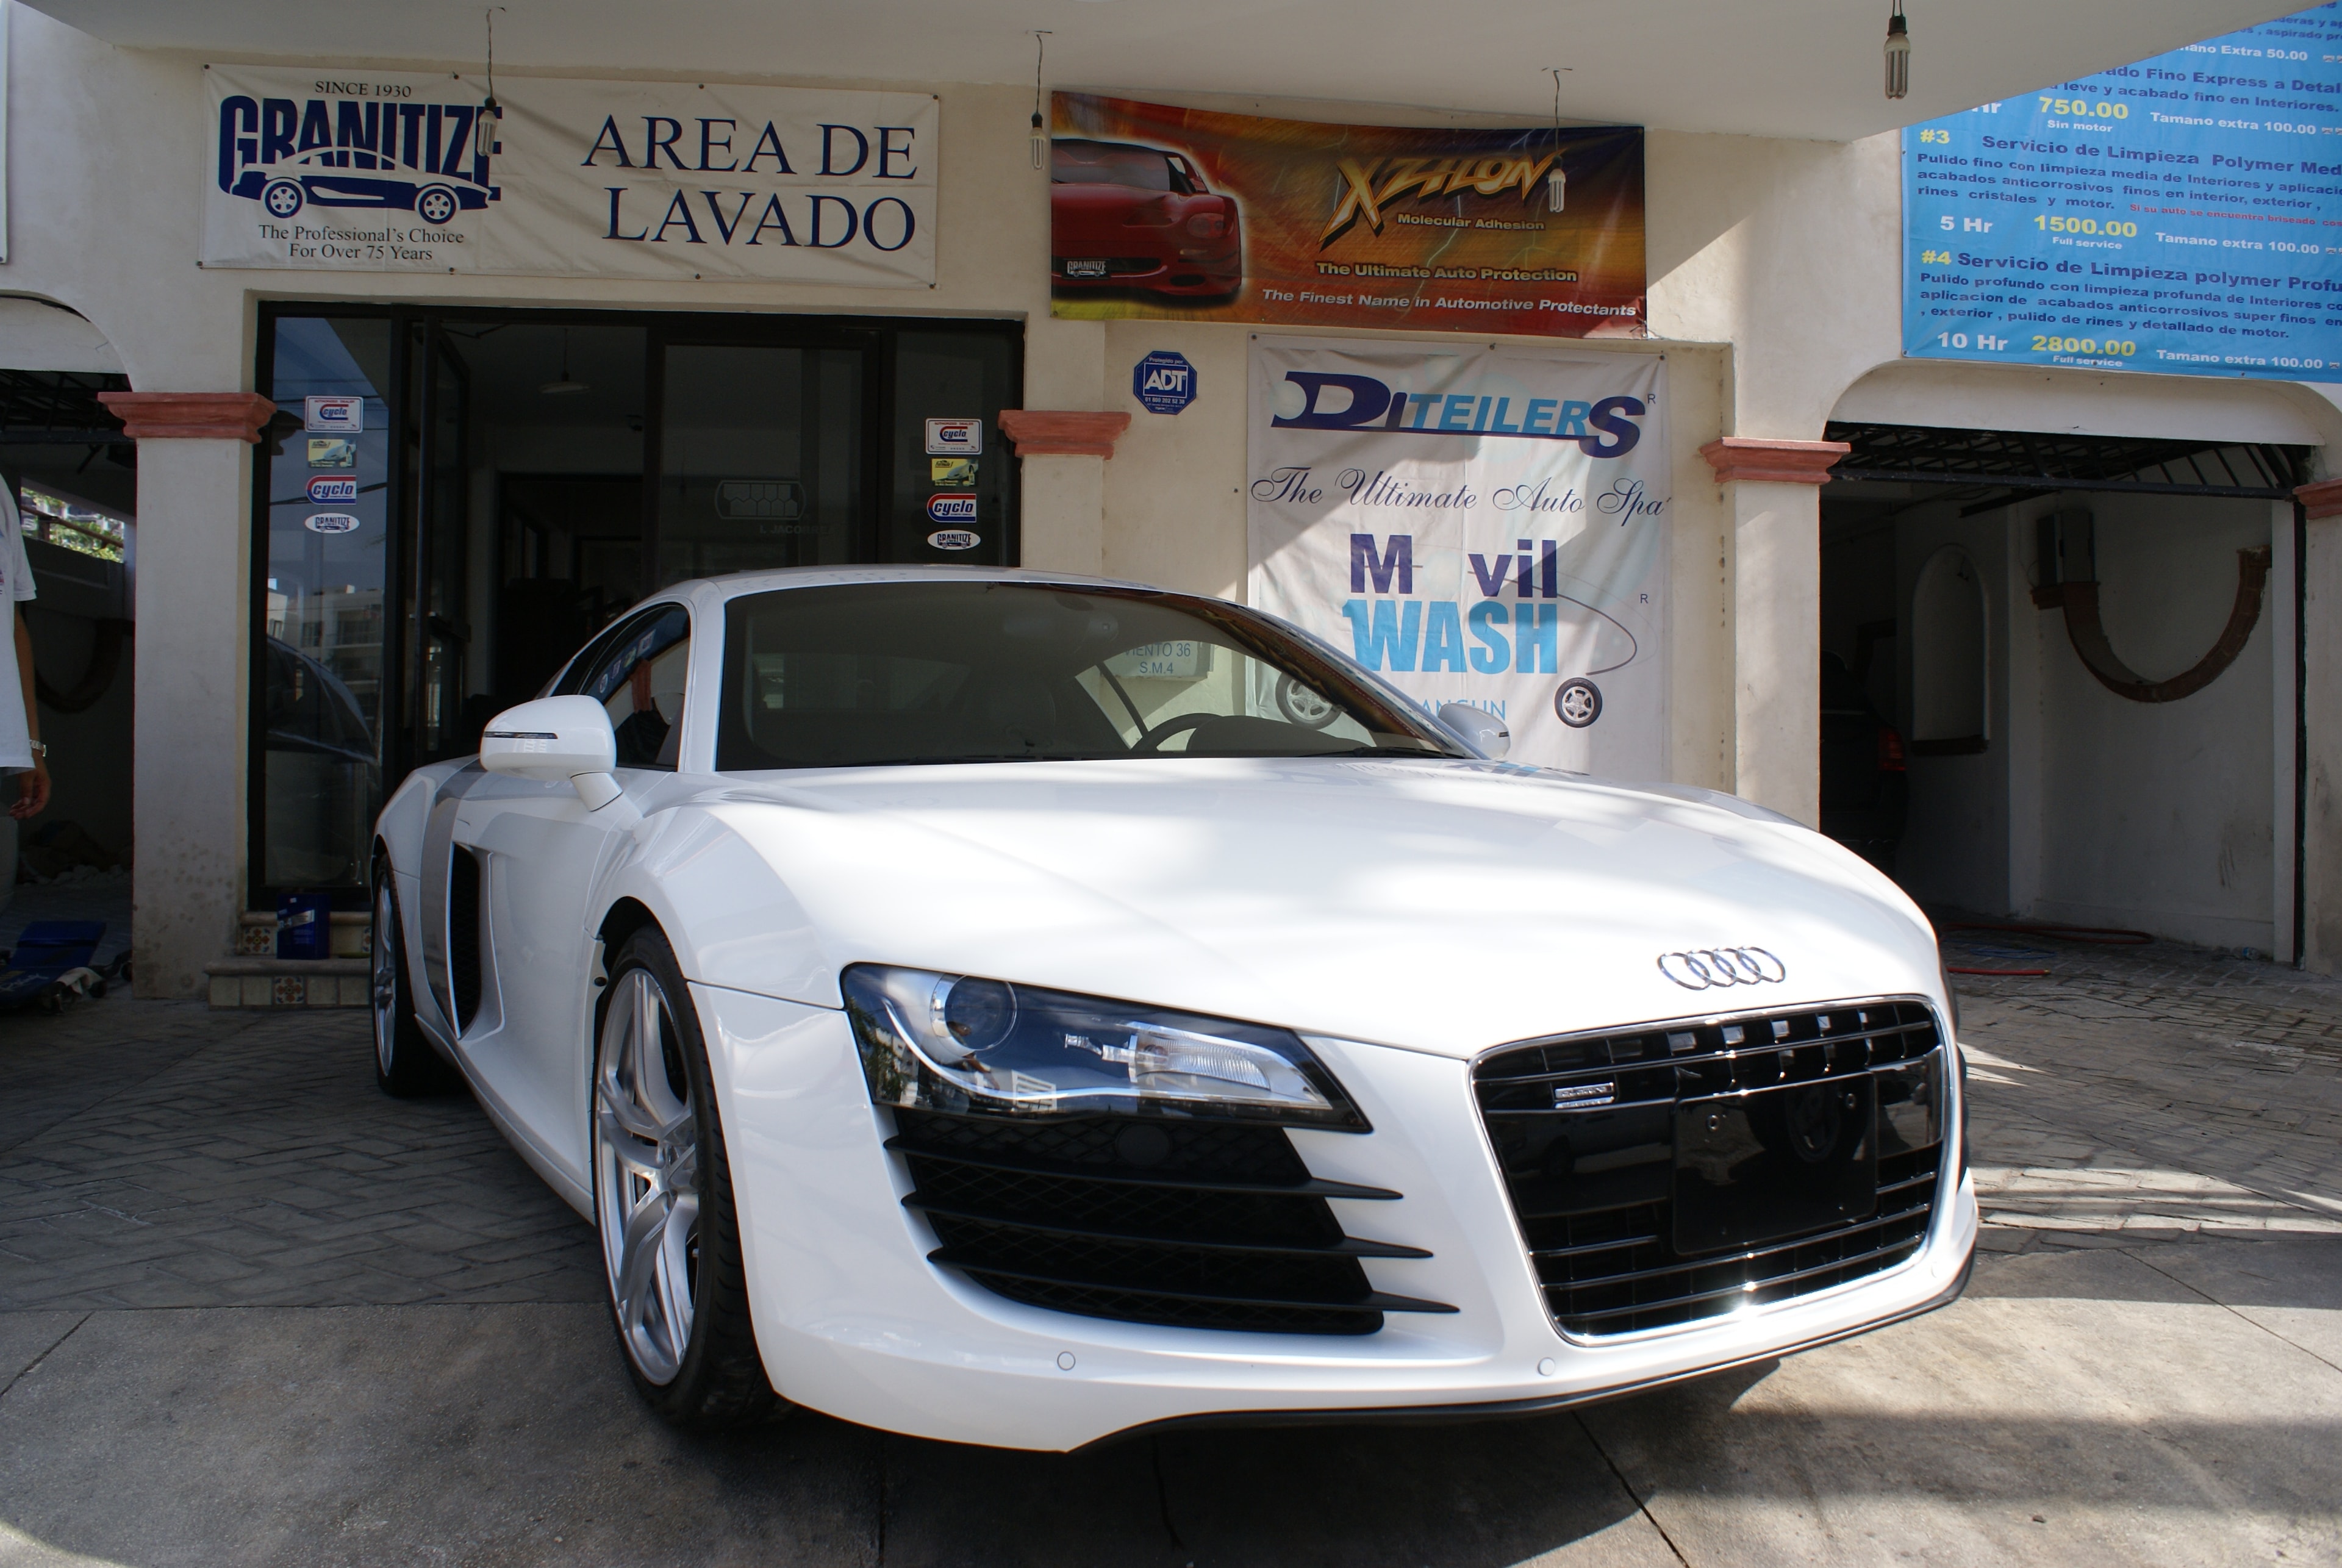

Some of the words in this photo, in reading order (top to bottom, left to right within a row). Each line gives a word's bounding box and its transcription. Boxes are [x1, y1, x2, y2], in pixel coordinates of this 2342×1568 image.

[2266, 29, 2322, 38] aspirado
[2221, 46, 2261, 57] Extra
[2267, 49, 2308, 61] 50.00
[315, 81, 368, 95] SINCE
[374, 84, 412, 98] 1930
[2098, 66, 2140, 77] ado
[2147, 68, 2186, 81] Fino
[2193, 72, 2268, 88] Express
[2274, 81, 2285, 89] a
[2064, 83, 2098, 92] leve
[2104, 87, 2112, 96] y
[2118, 87, 2189, 100] acabado
[2194, 92, 2225, 102] fino
[2230, 95, 2249, 106] en
[2255, 96, 2339, 112] Interiores.
[2038, 96, 2129, 119] 750.00
[2150, 112, 2213, 127] Tamano
[2218, 116, 2258, 129] extra
[2265, 121, 2316, 134] 100.00
[2047, 120, 2069, 129] Sin
[2074, 122, 2113, 132] motor
[218, 95, 503, 201] GRANITIZE
[580, 113, 798, 174] AREA
[815, 123, 918, 179] DE
[1921, 129, 1950, 145] #3
[1983, 135, 2068, 154] Servicio
[2075, 144, 2100, 156] de
[2108, 146, 2199, 164] Limpieza
[2213, 154, 2294, 171] Polymer
[1918, 154, 1968, 165] Pulido
[1973, 157, 2003, 168] fino
[2009, 162, 2035, 172] con
[2041, 164, 2105, 177] limpieza
[2111, 169, 2158, 181] media
[2163, 173, 2182, 182] de
[2188, 174, 2260, 189] Interiores
[2266, 182, 2274, 192] y
[1918, 171, 1996, 184] acabados
[2002, 177, 2113, 193] anticorrosivos
[2123, 186, 2160, 197] finos
[2166, 189, 2184, 198] en
[2189, 190, 2247, 205] interior,
[2252, 197, 2312, 209] exterior
[1918, 187, 1958, 197] rines
[1969, 191, 2037, 203] cristales
[2048, 198, 2055, 206] y
[2066, 199, 2115, 209] motor.
[601, 187, 916, 251] LAVADO
[1397, 213, 1471, 228] Molecular
[1475, 218, 1545, 230] Adhesion
[2207, 210, 2264, 221] encuentra
[2268, 214, 2316, 225] briseado
[259, 224, 290, 240] The
[409, 228, 464, 244] Choice
[1940, 216, 1955, 231] 5
[1963, 218, 1993, 233] Hr
[2034, 215, 2137, 238] 1500.00
[2155, 232, 2217, 246] Tamano
[2222, 238, 2263, 249] extra
[2269, 242, 2319, 254] 100.00
[2052, 237, 2072, 245] Full
[2075, 239, 2122, 250] service
[289, 243, 317, 259] For
[321, 244, 362, 260] Over
[366, 245, 385, 260] 75
[390, 246, 433, 261] Years
[1316, 262, 1351, 275] The
[1355, 263, 1431, 278] Ultimate
[1434, 267, 1477, 279] Auto
[1481, 268, 1577, 282] Protection
[1922, 250, 1951, 265] #4
[1958, 253, 2048, 271] Servicio
[2056, 260, 2082, 273] de
[2091, 262, 2187, 281] Limpieza
[2196, 272, 2281, 287] polymer
[1262, 289, 1294, 301] The
[1300, 292, 1353, 305] Finest
[1358, 295, 1410, 307] Name
[1415, 296, 1430, 307] in
[1434, 296, 1534, 310] Automotive
[1539, 299, 1636, 315] Protectants
[1921, 273, 1969, 285] Pulido
[1974, 277, 2044, 290] profundo
[2050, 284, 2079, 292] con
[2084, 284, 2148, 297] limpieza
[2154, 290, 2221, 303] profunda
[2227, 294, 2244, 304] de
[2250, 296, 2322, 309] Interiores
[1921, 291, 2003, 303] aplicacion
[2008, 296, 2027, 304] de
[2038, 298, 2113, 310] acabados
[2119, 303, 2228, 318] anticorrosivos
[2233, 310, 2276, 322] super
[2280, 313, 2316, 324] finos
[1931, 307, 1993, 319] exterior
[2008, 312, 2056, 323] pulido
[2061, 315, 2080, 324] de
[2086, 317, 2124, 328] rines
[2129, 321, 2137, 330] y
[2143, 320, 2213, 333] detallado
[2219, 325, 2236, 334] de
[2241, 327, 2289, 338] motor.
[1937, 332, 1968, 349] 10
[1977, 335, 2008, 351] Hr
[2032, 335, 2136, 357] 2800.00
[2157, 349, 2219, 363] Tamano
[2225, 355, 2266, 366] extra
[2271, 357, 2322, 369] 100.00
[2053, 355, 2073, 363] Full
[2076, 357, 2123, 367] service
[1145, 369, 1187, 392] ADT
[313, 482, 354, 498] cyclo
[1251, 466, 1323, 505] The
[1334, 468, 1477, 510] Ultimate
[1492, 476, 1585, 513] Auto
[1595, 477, 1671, 527] Spa
[934, 500, 974, 515] cyclo
[1342, 599, 1558, 675] WASH
[1125, 642, 1172, 657] IENTO
[1176, 643, 1191, 657] 36
